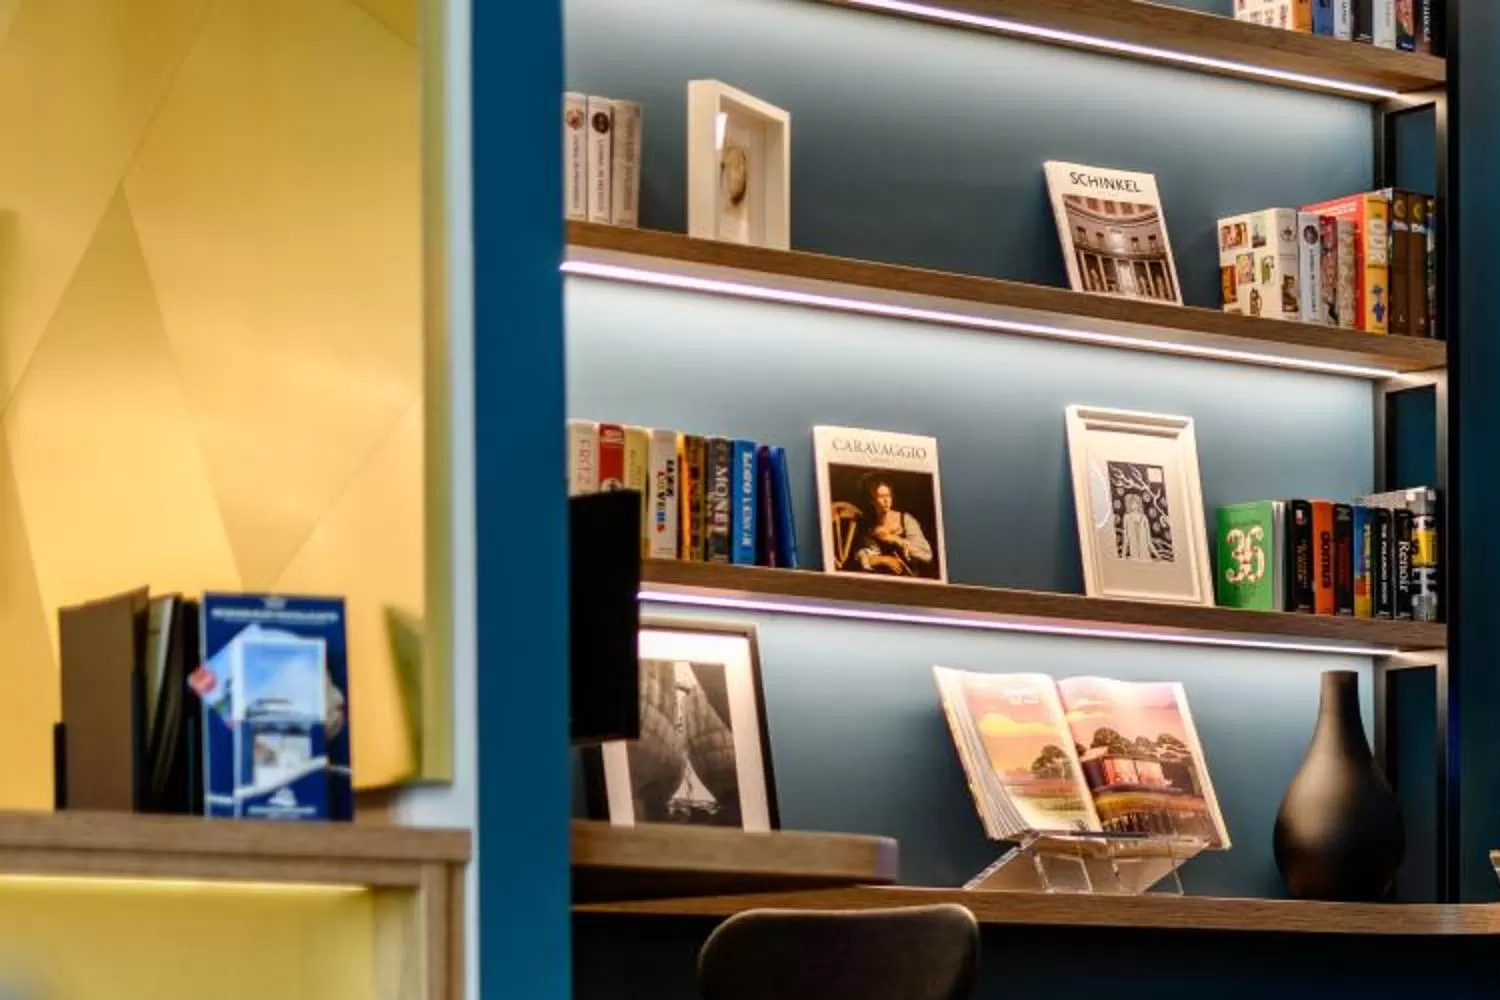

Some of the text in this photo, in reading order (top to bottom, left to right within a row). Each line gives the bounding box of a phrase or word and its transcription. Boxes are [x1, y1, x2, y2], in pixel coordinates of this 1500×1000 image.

[1069, 171, 1142, 192] SCHINKEL
[831, 437, 927, 460] CARAVAGGIO
[715, 465, 728, 533] MONET
[1398, 540, 1411, 593] Renoir
